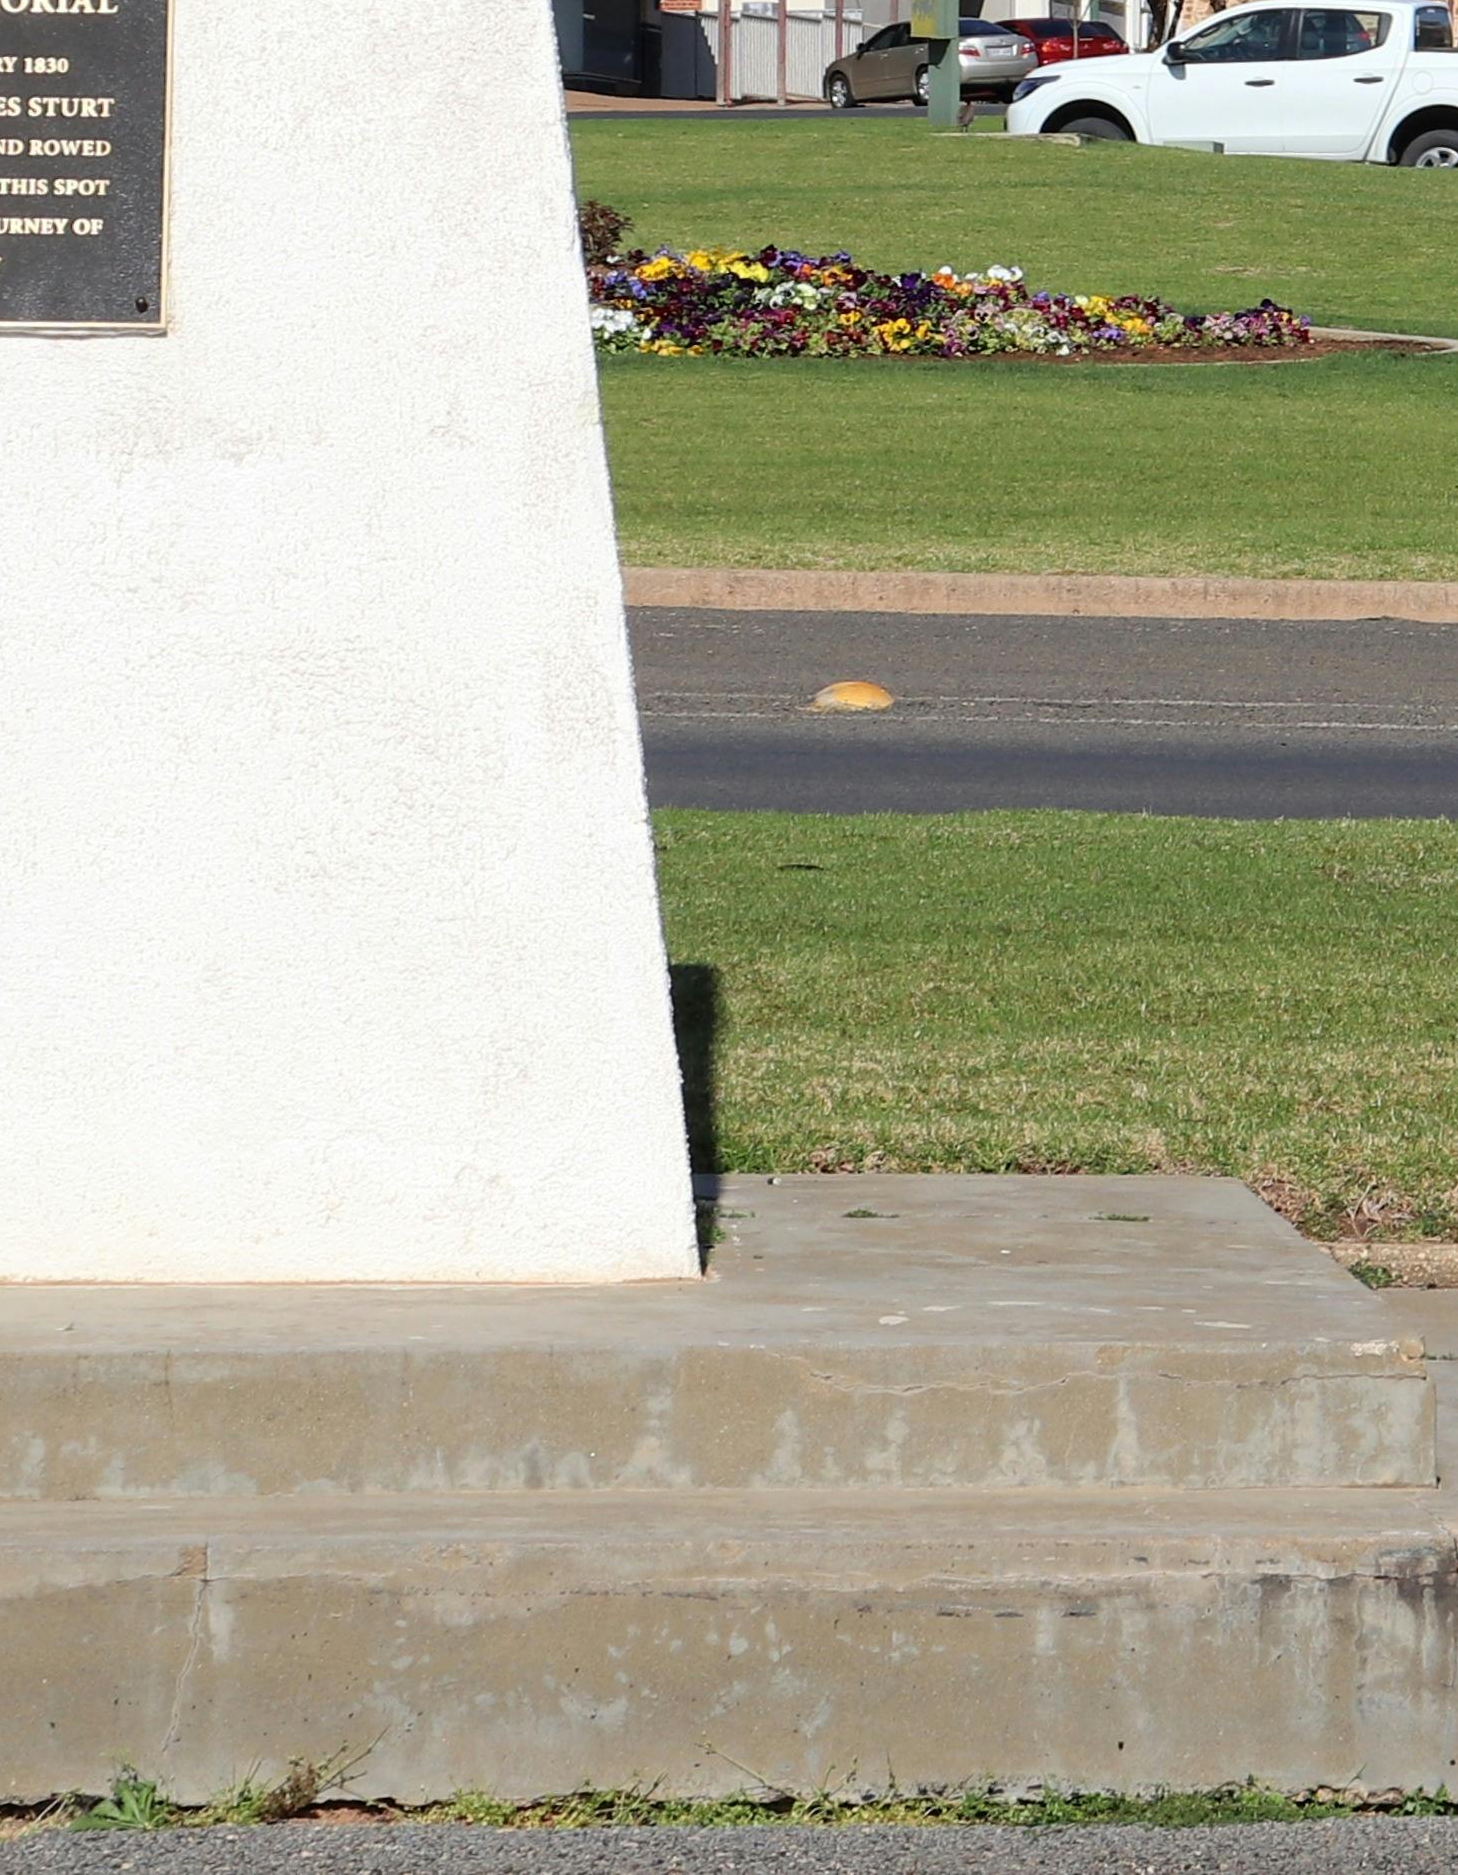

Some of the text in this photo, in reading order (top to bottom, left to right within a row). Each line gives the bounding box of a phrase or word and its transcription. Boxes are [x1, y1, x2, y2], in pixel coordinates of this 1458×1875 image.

[23, 56, 70, 74] 1830
[27, 96, 116, 118] STURT
[28, 138, 112, 157] ROWED
[53, 178, 111, 196] SPOT
[72, 217, 104, 236] OF
